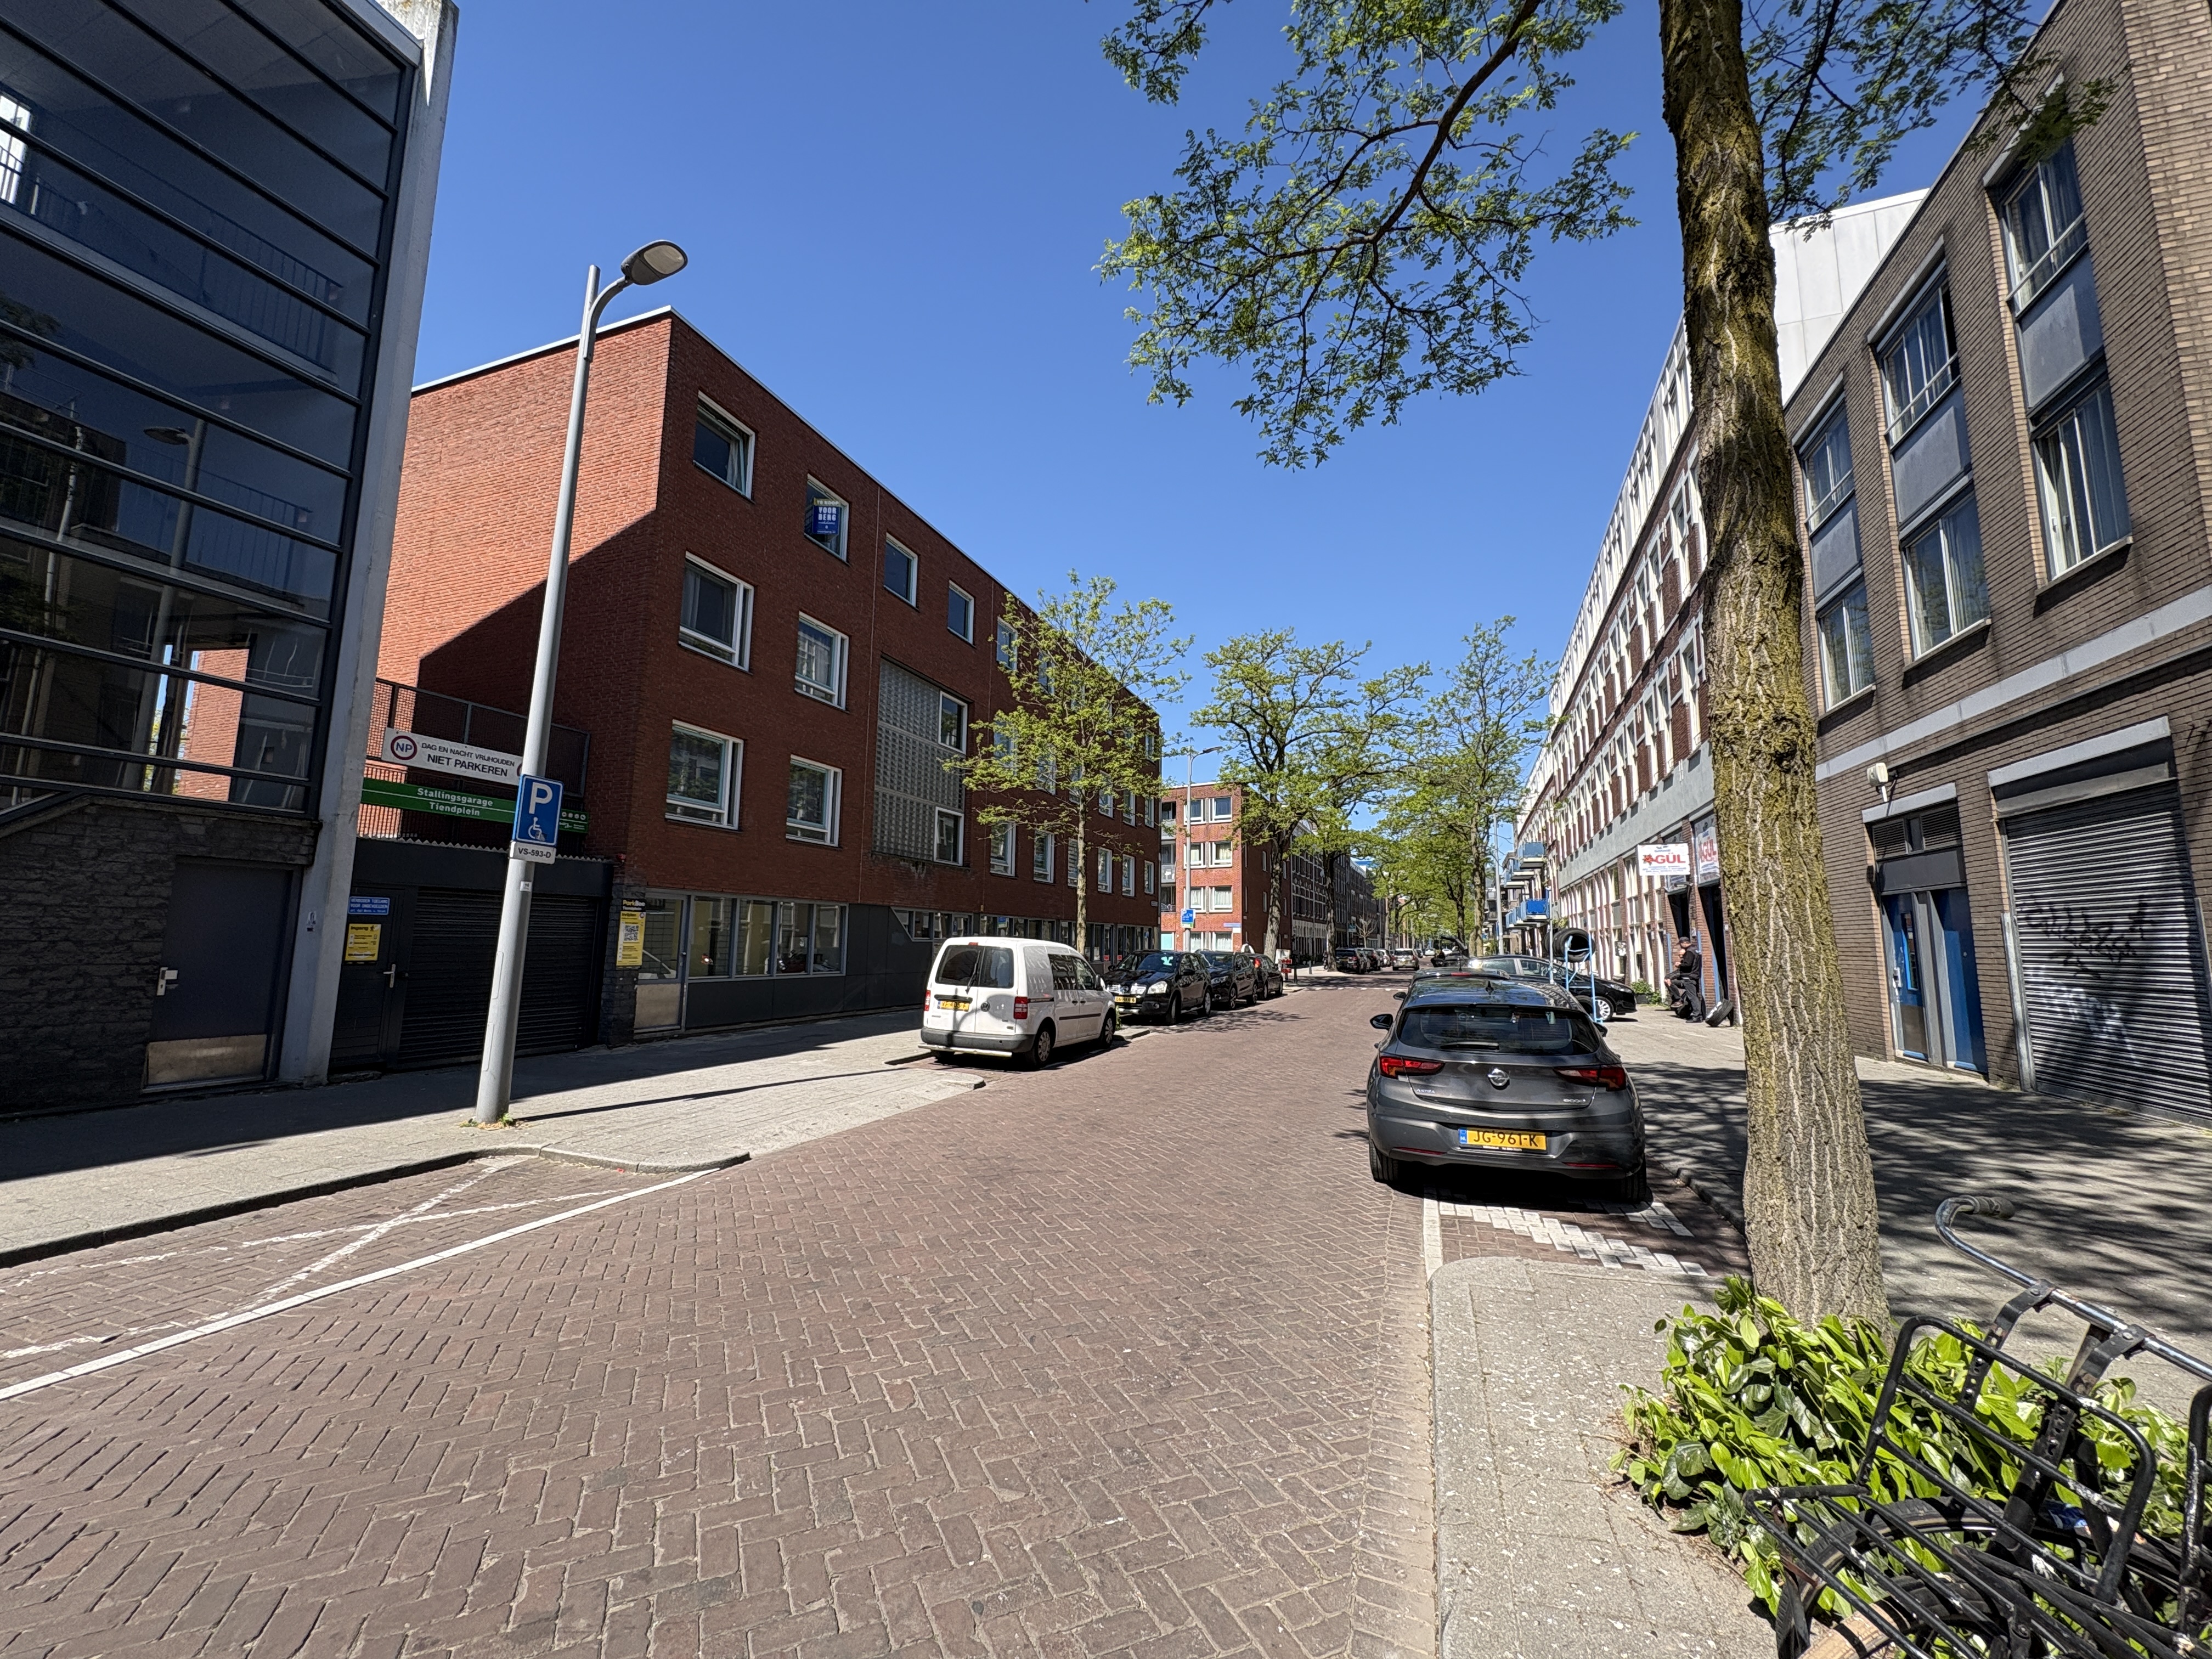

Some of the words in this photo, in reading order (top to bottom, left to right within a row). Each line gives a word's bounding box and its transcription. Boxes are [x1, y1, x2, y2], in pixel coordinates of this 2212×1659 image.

[396, 742, 413, 753] NP
[421, 742, 437, 751] DAG
[450, 748, 473, 758] NACHT
[475, 754, 515, 767] VRIJHOUDEN
[427, 754, 453, 766] NIET
[454, 759, 508, 777] PARKEREN
[417, 788, 493, 806] Stallingsgarage
[528, 782, 553, 815] P
[430, 802, 480, 816] Tiendplein
[518, 848, 551, 858] VS-593-D
[1655, 852, 1686, 864] GÜL
[1474, 1130, 1538, 1147] JG-961-K
